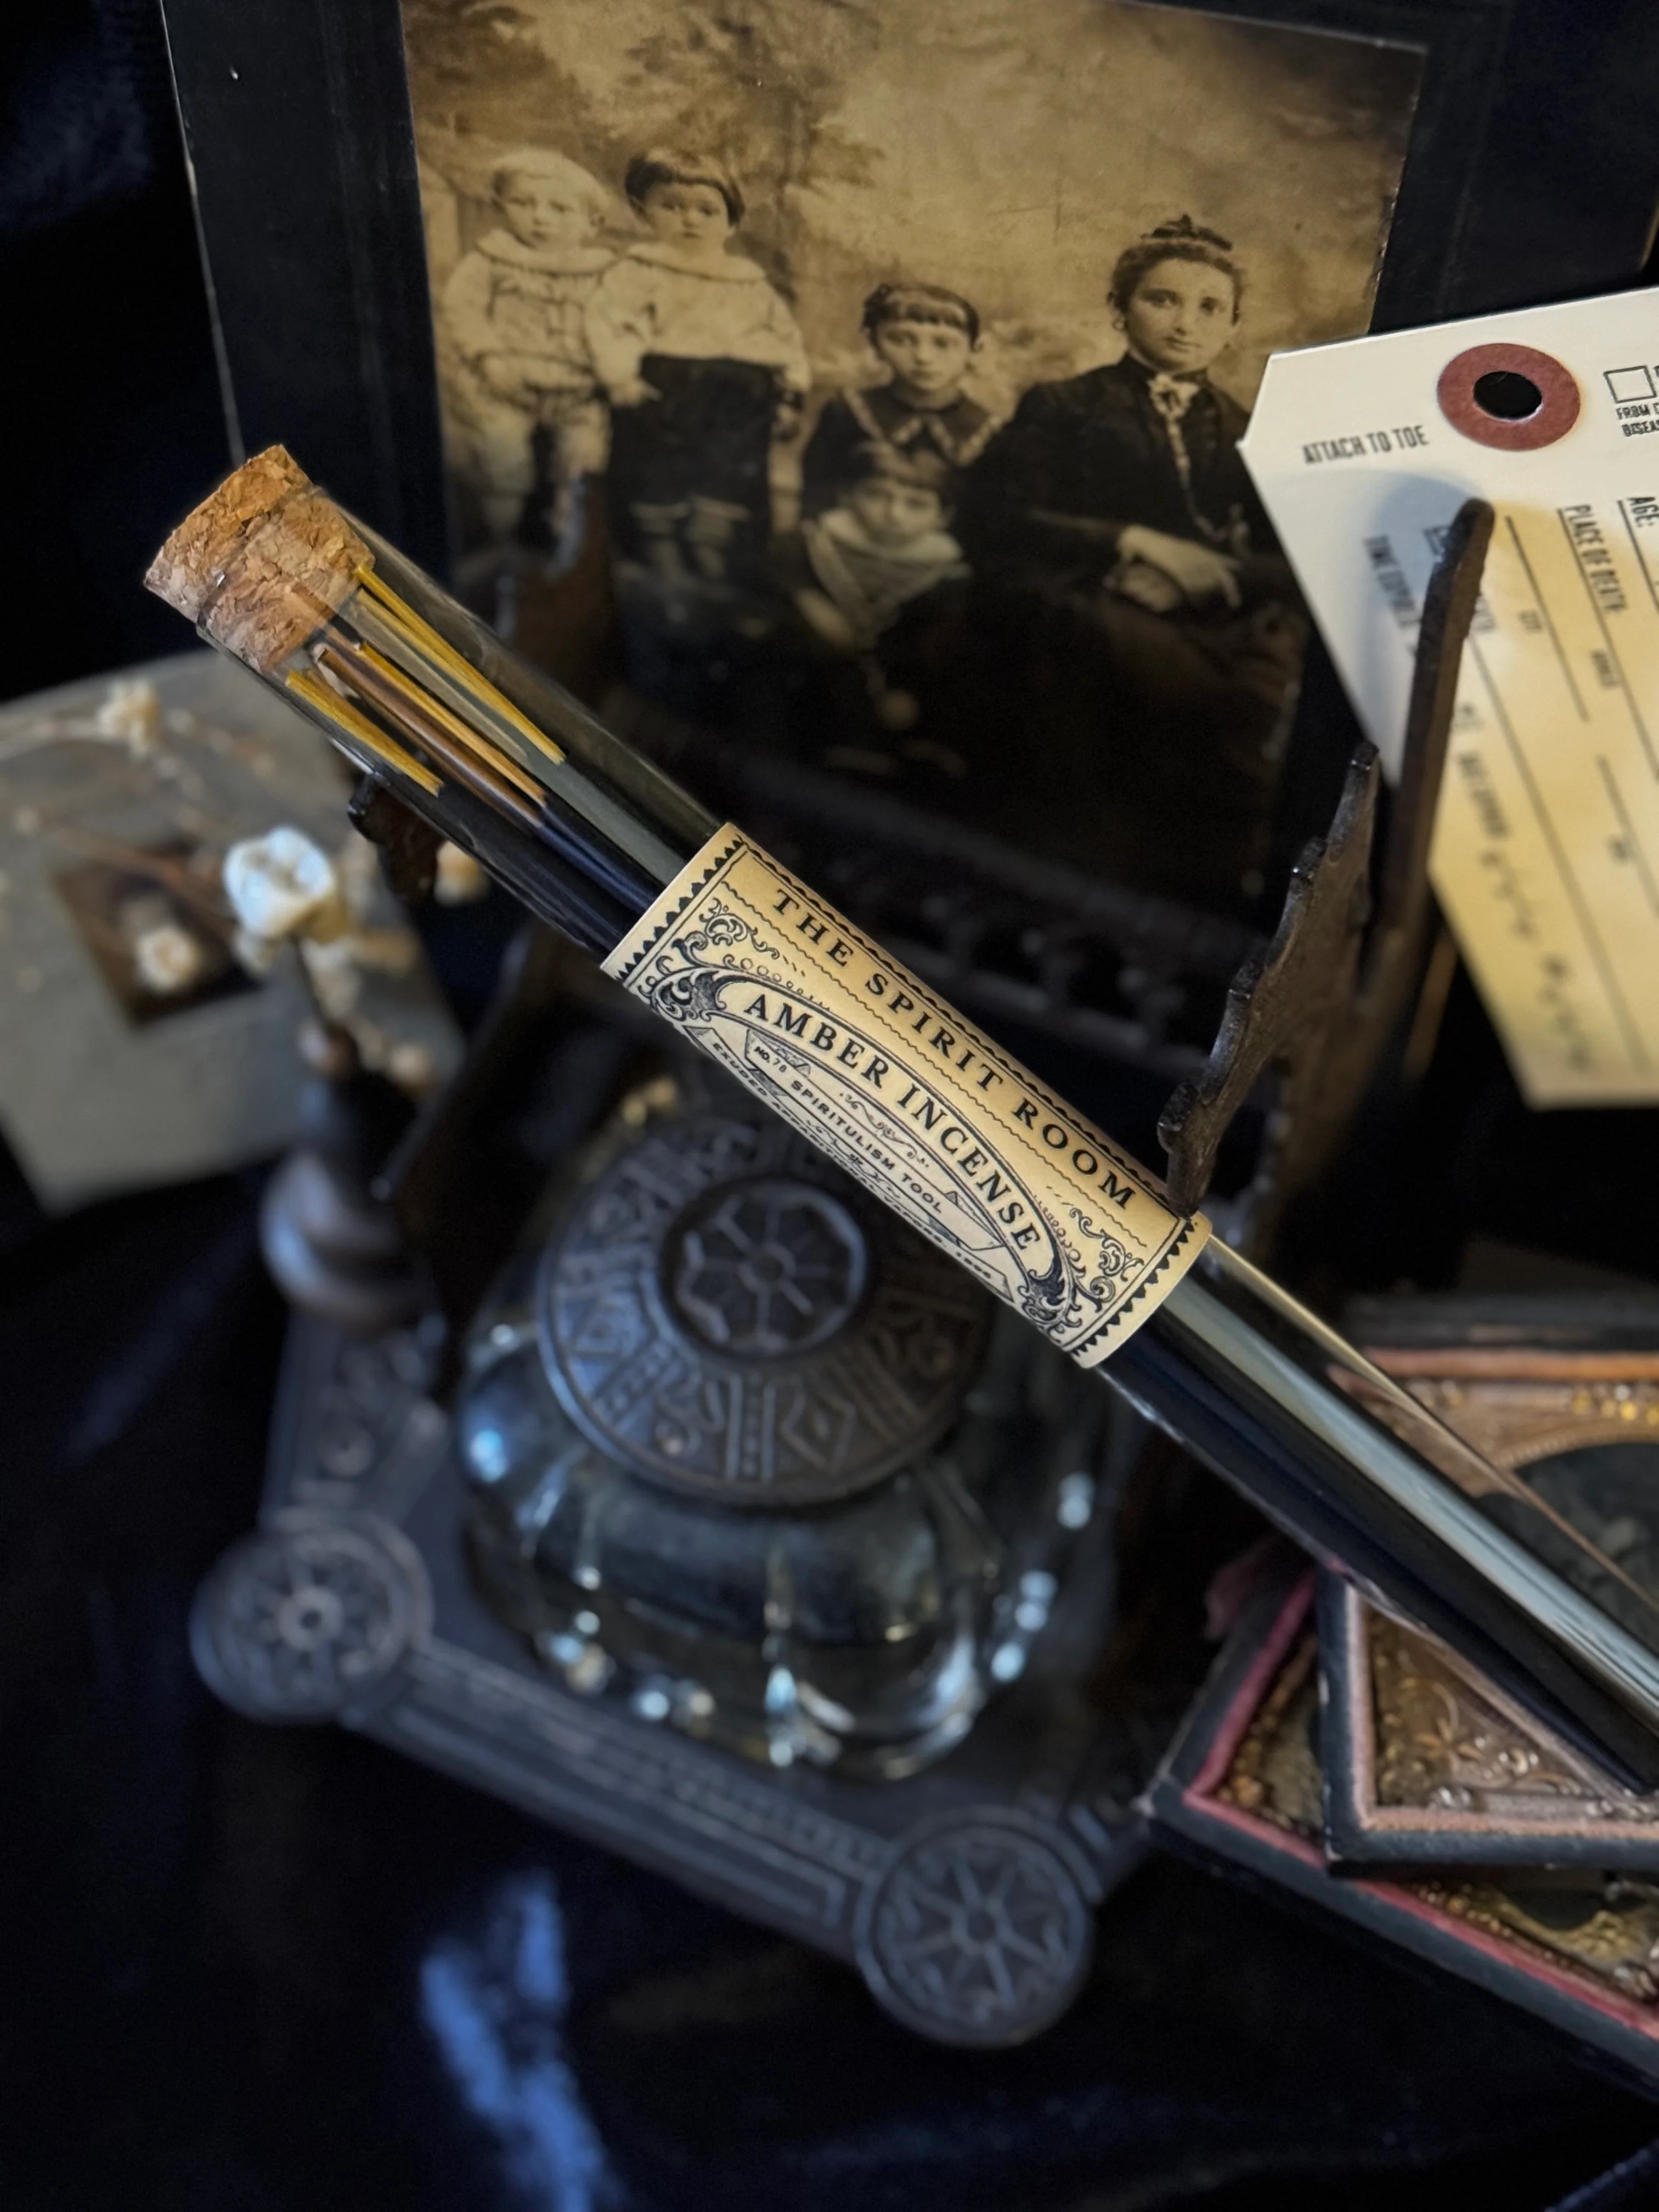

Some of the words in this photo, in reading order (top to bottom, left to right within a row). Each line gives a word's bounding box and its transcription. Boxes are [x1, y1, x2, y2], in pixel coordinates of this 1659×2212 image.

[1302, 436, 1367, 464] ATTACH
[1367, 431, 1391, 453] TO
[1391, 425, 1429, 449] TOE
[1565, 504, 1604, 546] PLACE
[1627, 496, 1659, 528] AGE:
[713, 1043, 768, 1096] EXUDED
[773, 888, 854, 967] THE
[865, 972, 1003, 1091] SPIRIT
[1013, 1098, 1137, 1209] ROOM
[744, 994, 889, 1089] AMBER
[898, 1084, 1041, 1250] INCENSE
[754, 1046, 770, 1063] NO.
[772, 1058, 787, 1073] 78
[791, 1080, 895, 1170] SPIRITULISM
[901, 1172, 942, 1214] TOOL
